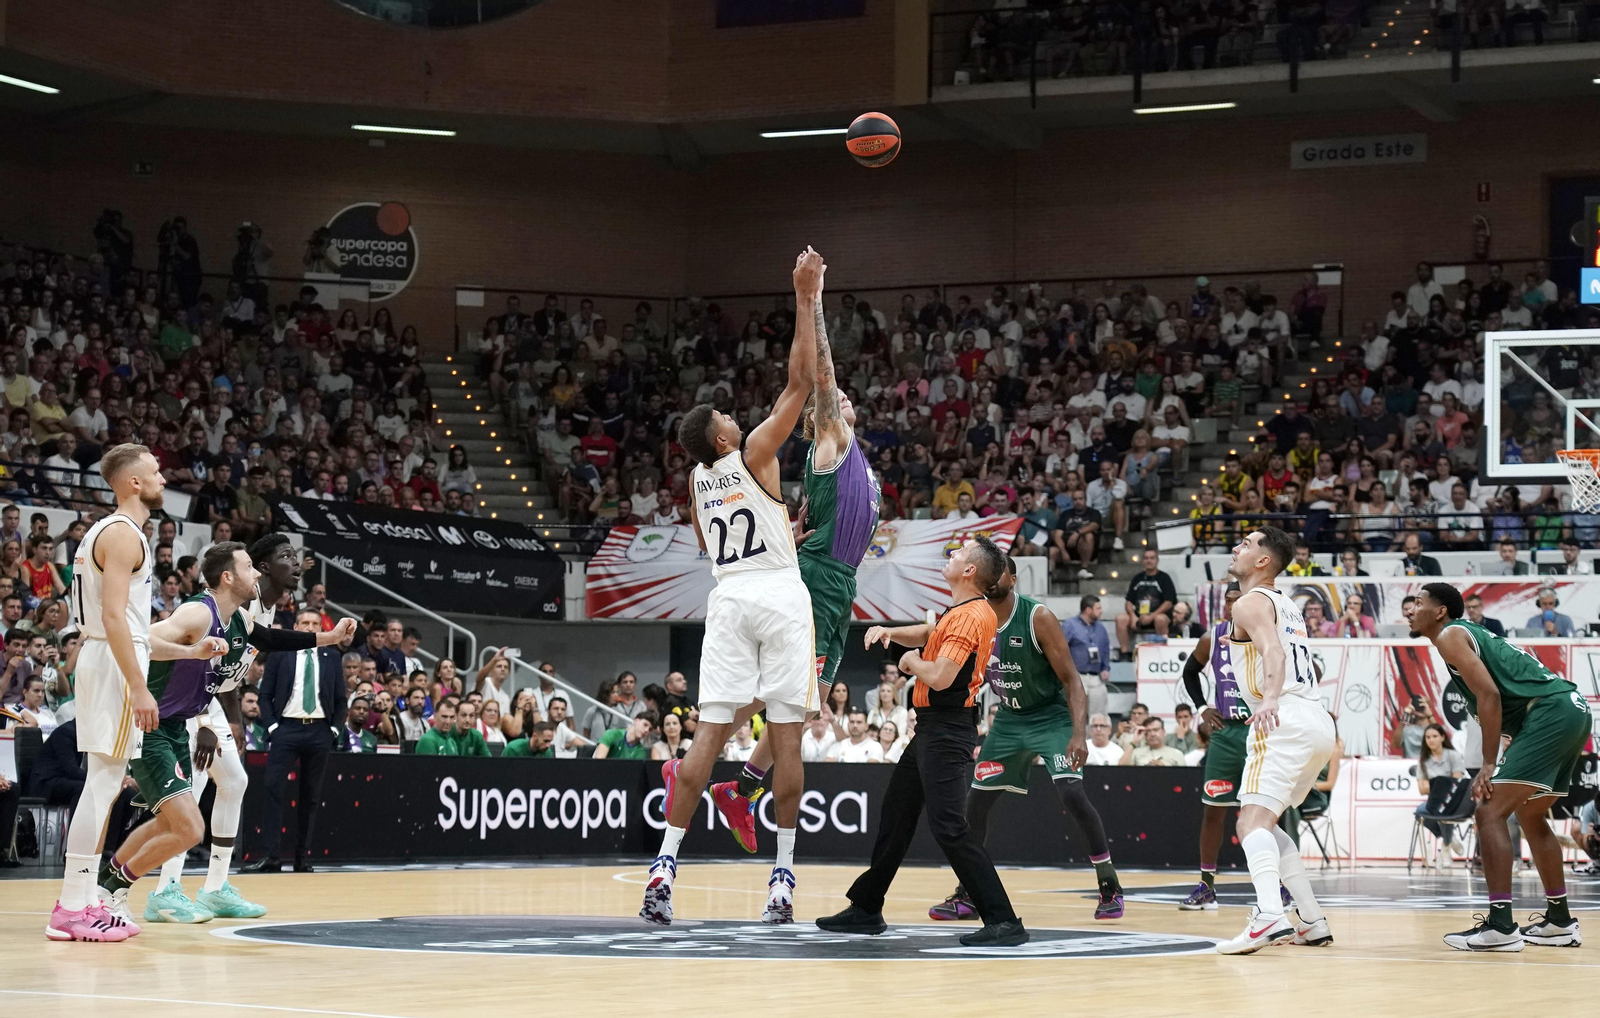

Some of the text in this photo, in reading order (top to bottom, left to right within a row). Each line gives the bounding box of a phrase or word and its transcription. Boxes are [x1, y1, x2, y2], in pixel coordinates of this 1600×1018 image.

[1302, 141, 1414, 161] Grada Este
[339, 251, 407, 268] endesa
[696, 471, 741, 493] TAVARES
[363, 520, 432, 541] endesa
[708, 508, 767, 566] 22
[543, 602, 557, 613] acb
[1148, 660, 1180, 673] acb
[992, 679, 1022, 690] málaga
[1229, 706, 1249, 720] 55
[1371, 775, 1411, 791] acb
[438, 776, 627, 840] Supercopa
